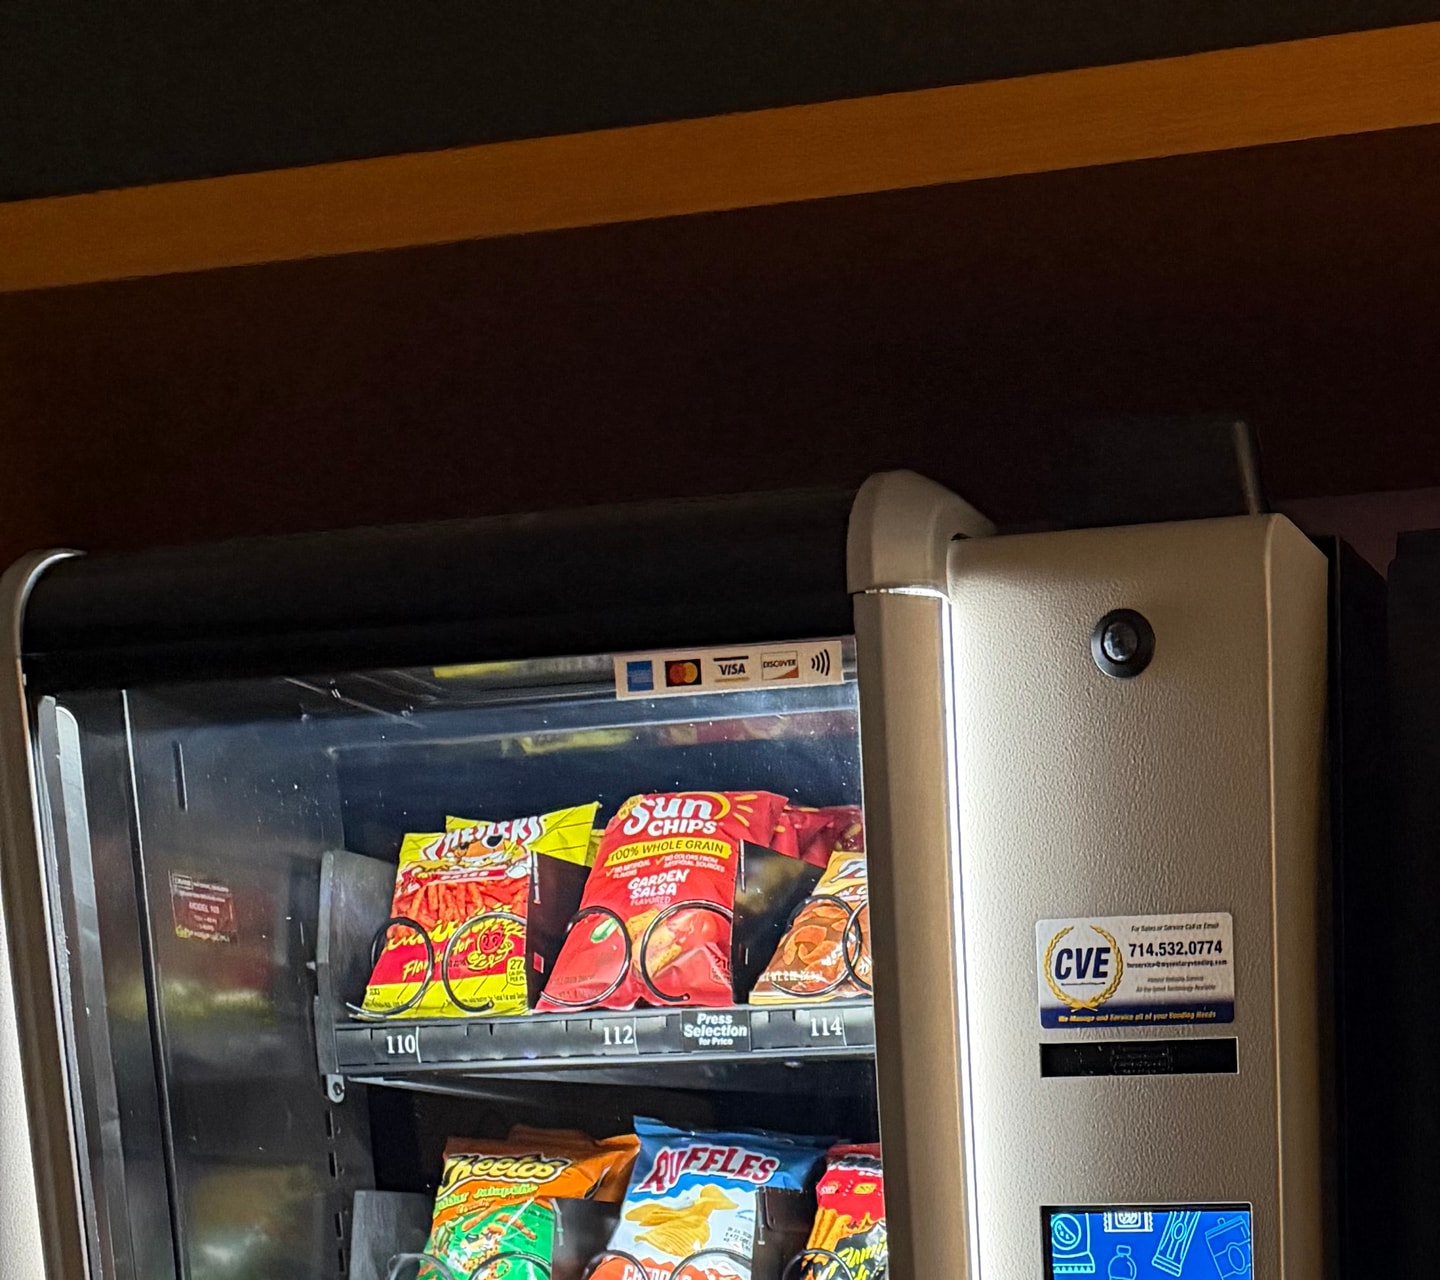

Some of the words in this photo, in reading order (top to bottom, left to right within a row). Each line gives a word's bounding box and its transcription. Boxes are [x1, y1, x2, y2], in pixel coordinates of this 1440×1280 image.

[718, 663, 746, 676] VISA
[763, 659, 796, 669] DISCOVER
[623, 796, 713, 836] Sun
[648, 820, 717, 836] CHIPS
[611, 846, 639, 862] 100%
[642, 839, 682, 855] WHOLE
[684, 839, 724, 854] GRAIN
[628, 868, 690, 889] GARDEN
[630, 883, 677, 899] SALSA
[1129, 940, 1223, 957] 714.532.0774
[1054, 947, 1111, 980] CVE
[697, 1013, 733, 1025] Press
[811, 1017, 843, 1037] 114
[603, 1026, 634, 1046] 112
[683, 1024, 748, 1038] Selection
[387, 1035, 416, 1054] 110
[699, 1037, 710, 1046] for
[711, 1037, 734, 1046] Price
[638, 1146, 777, 1192] RUFFLES
